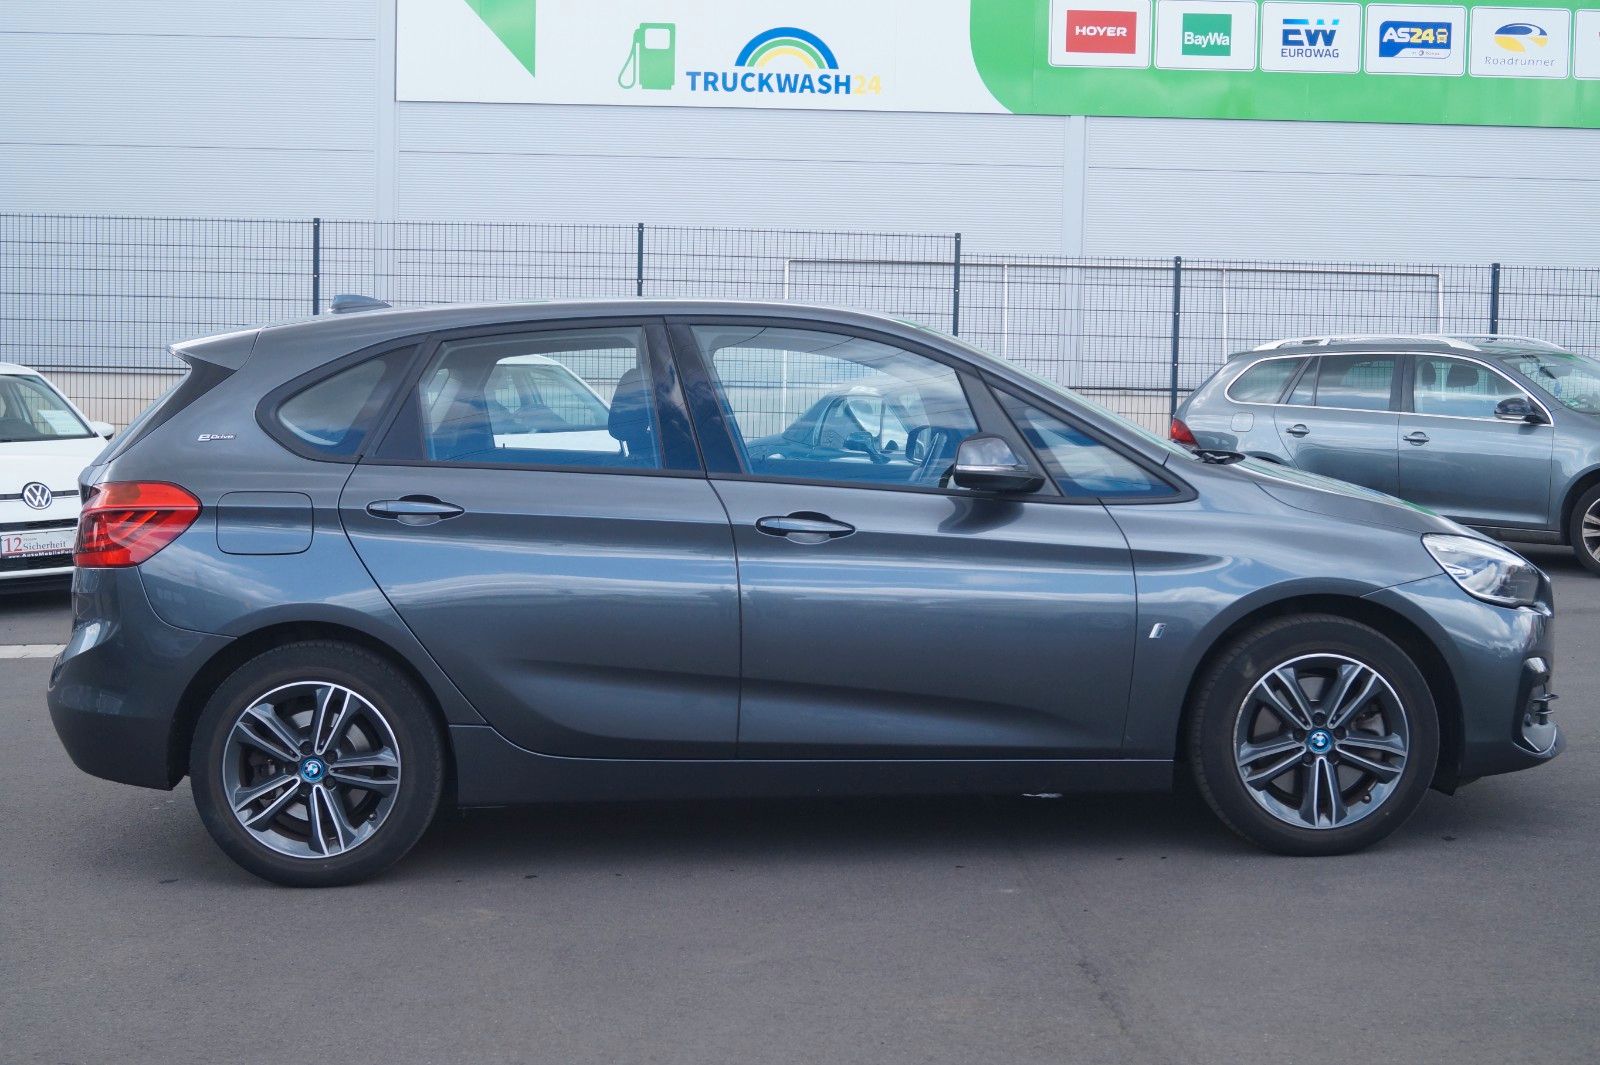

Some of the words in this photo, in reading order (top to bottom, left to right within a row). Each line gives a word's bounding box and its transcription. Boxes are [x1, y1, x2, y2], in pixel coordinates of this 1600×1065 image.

[1075, 26, 1127, 37] HOYER
[1382, 27, 1435, 43] AS24
[1184, 31, 1230, 48] BayWa
[1281, 48, 1339, 58] EUROWAG
[1484, 56, 1556, 67] Roadrunner
[686, 71, 882, 95] TRUCKWASH24
[4, 537, 22, 552] 12
[23, 541, 67, 550] Sicherheit
